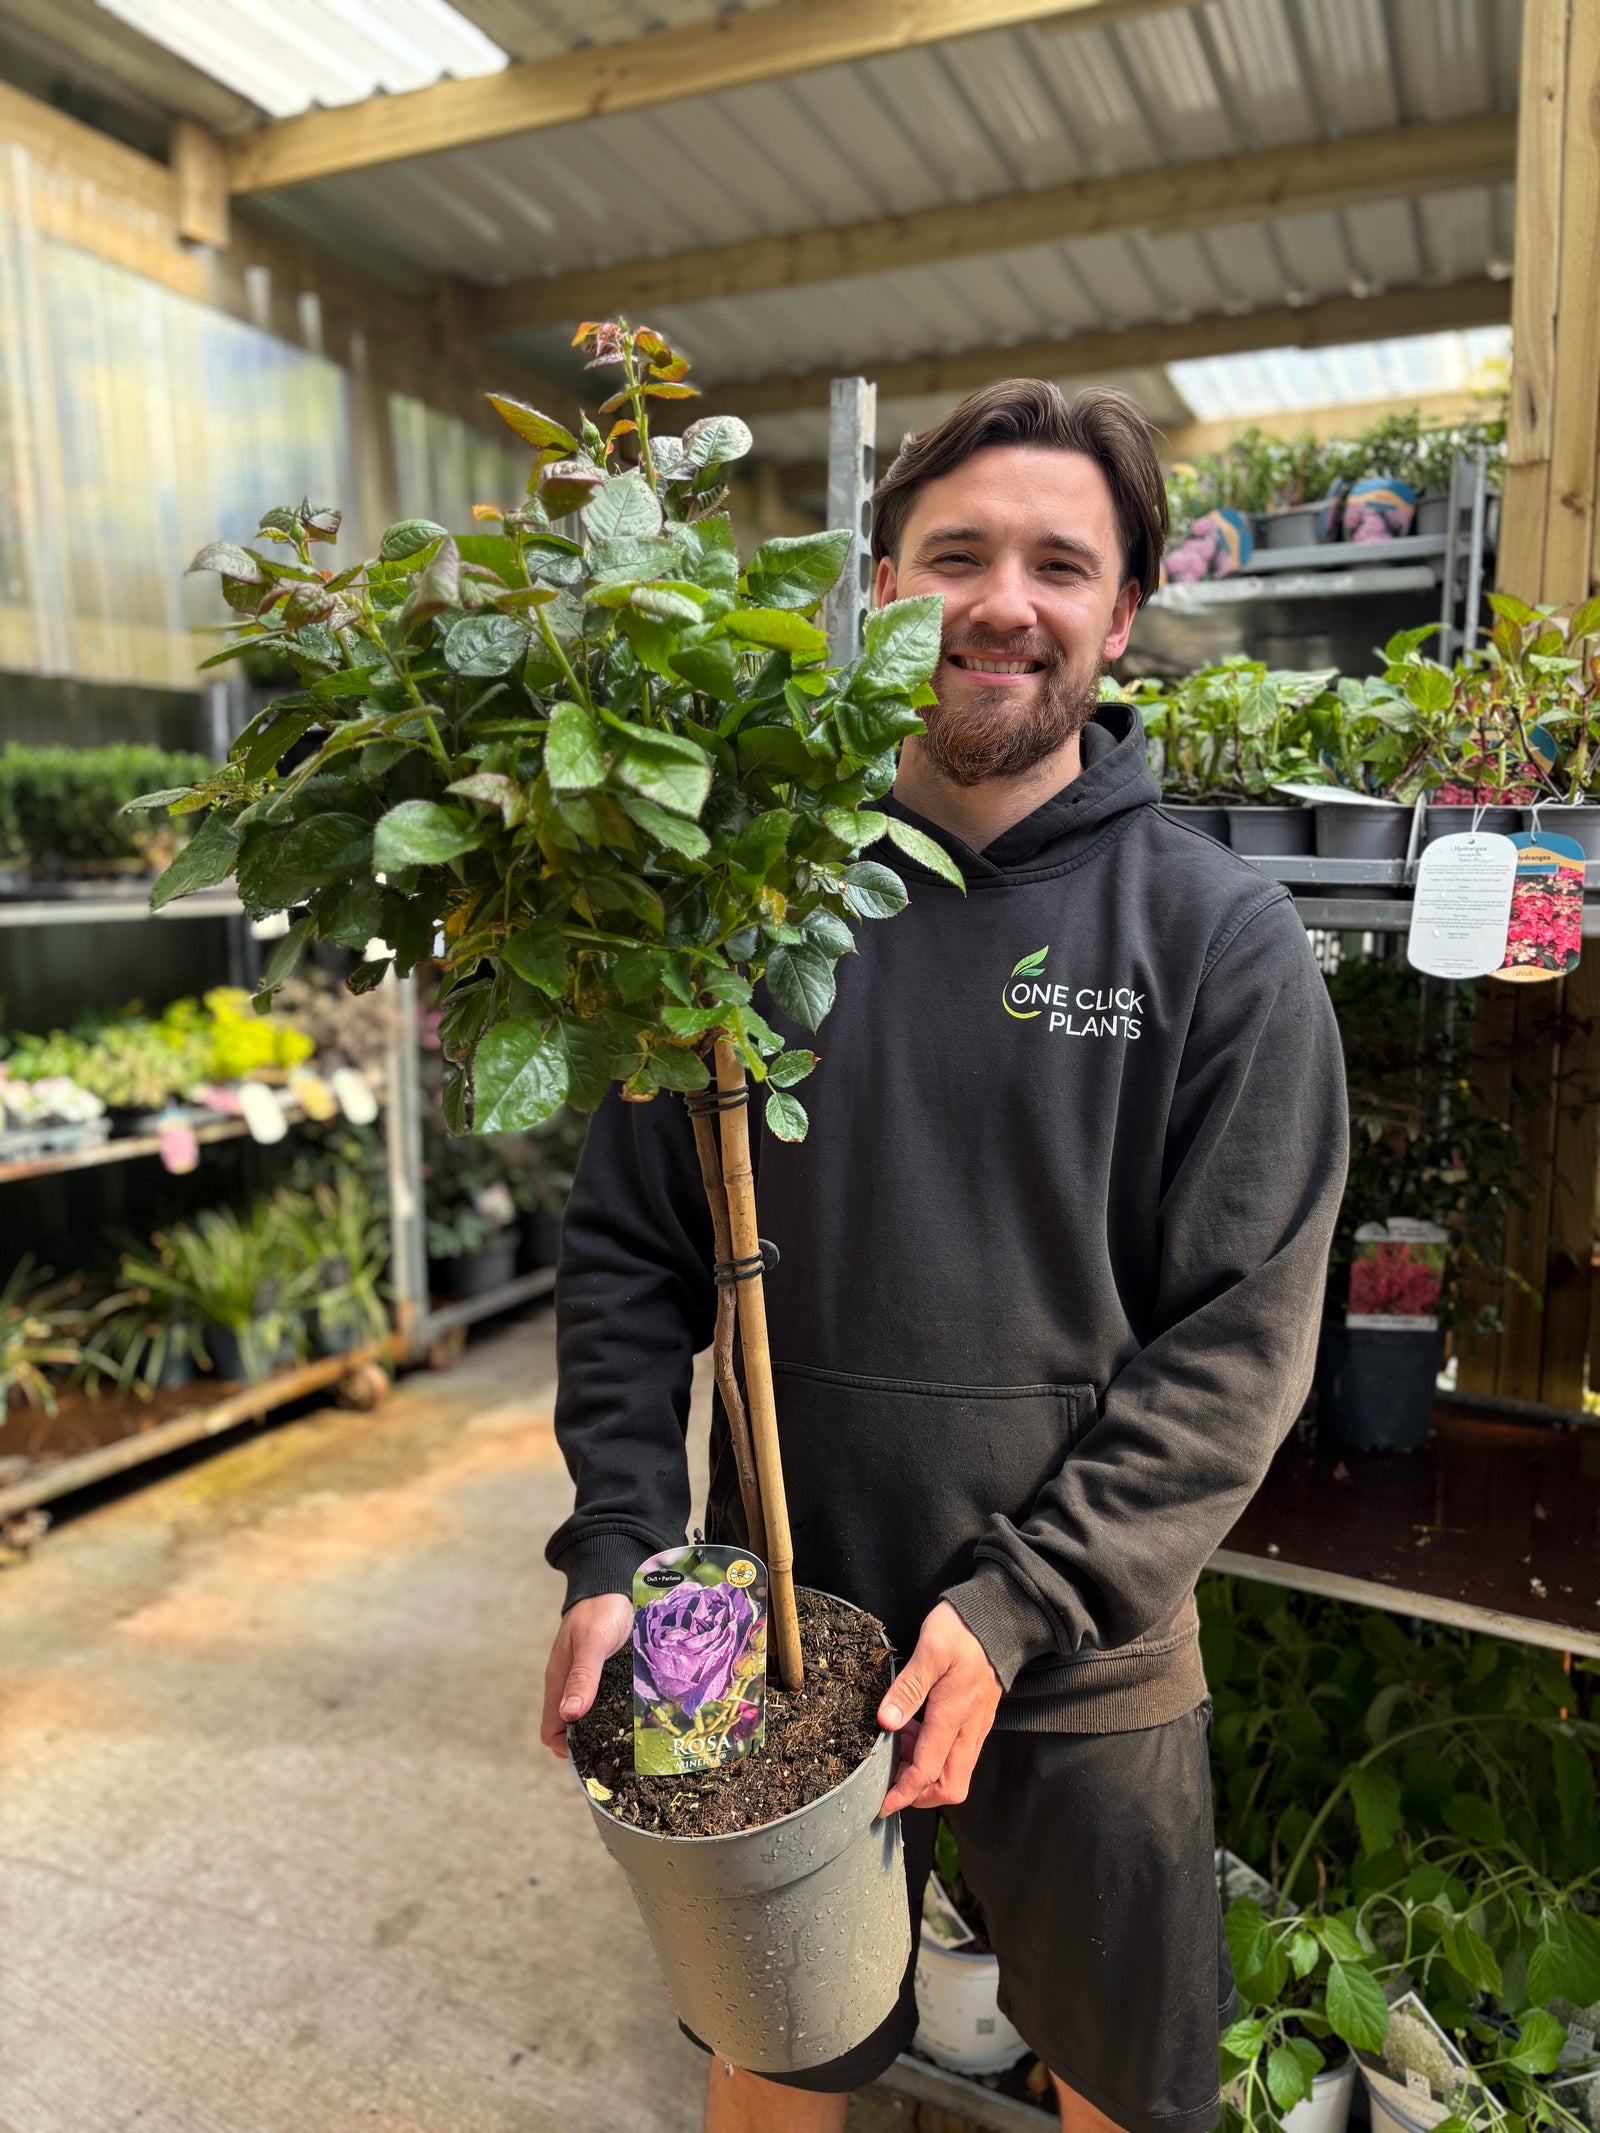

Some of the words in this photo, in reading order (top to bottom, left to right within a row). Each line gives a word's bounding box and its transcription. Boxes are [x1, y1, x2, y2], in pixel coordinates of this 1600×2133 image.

[1011, 983, 1069, 1008] ONE
[1075, 987, 1146, 1014] CLICK
[1049, 1011, 1142, 1040] PLANTS
[672, 1734, 733, 1757] ROSA
